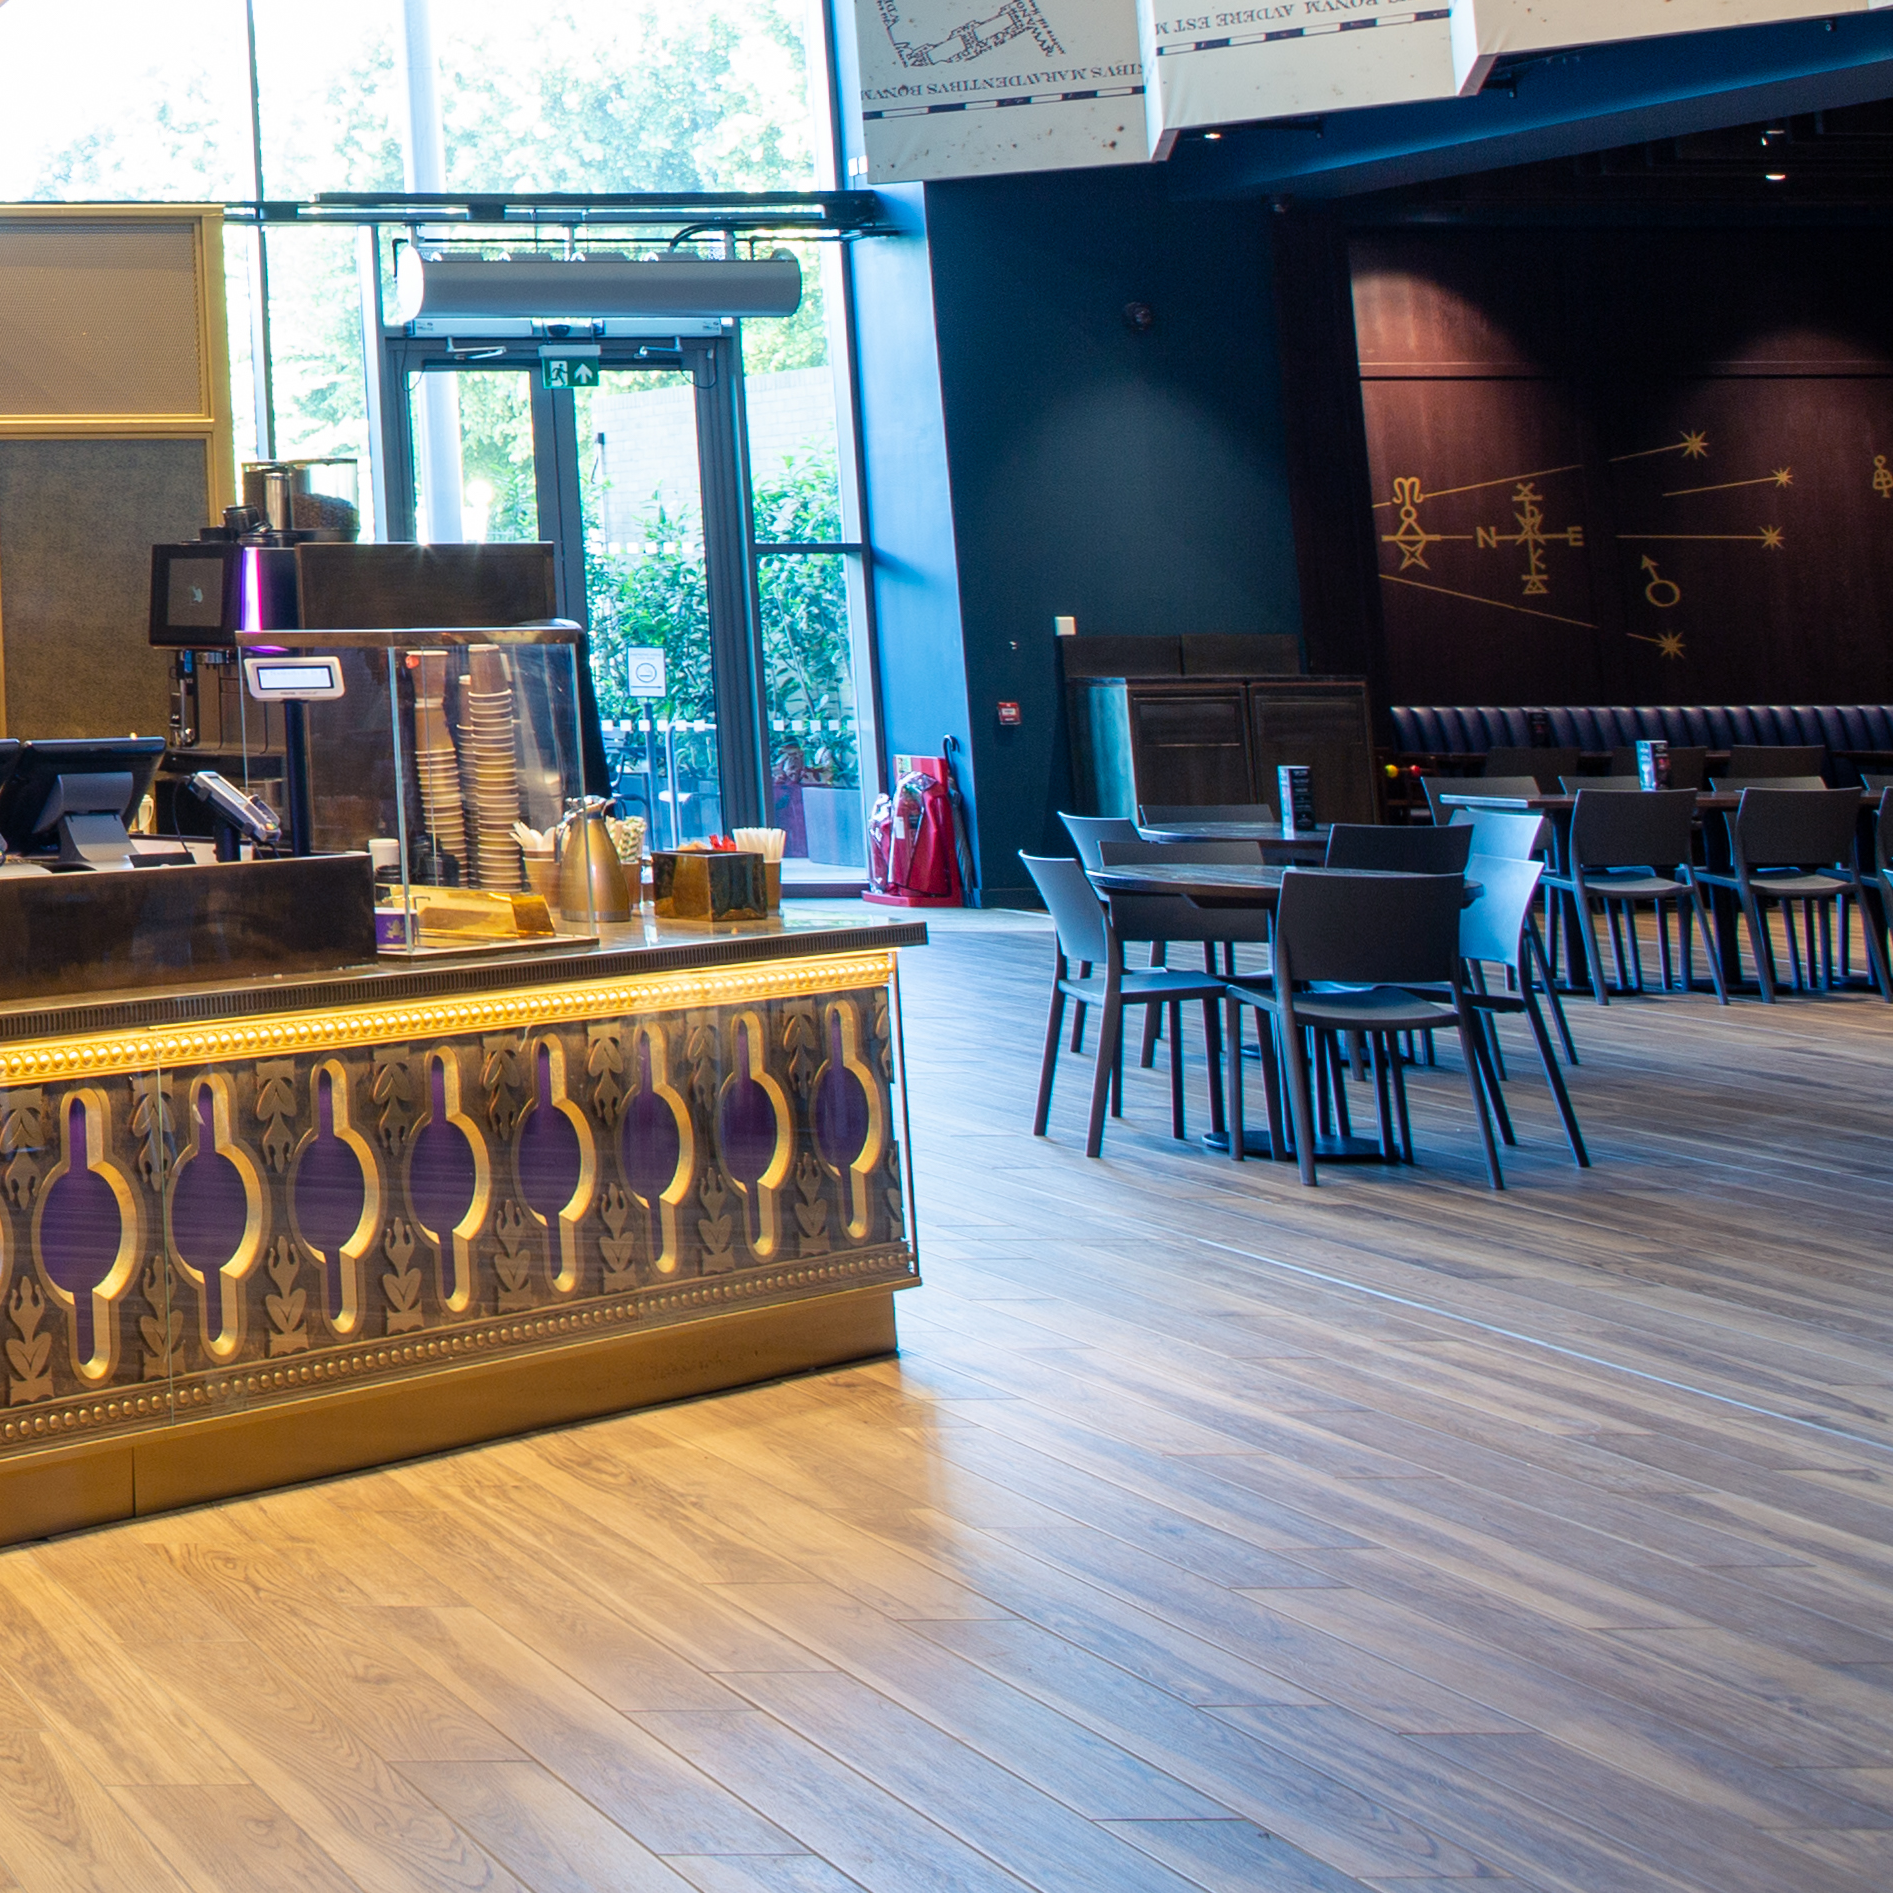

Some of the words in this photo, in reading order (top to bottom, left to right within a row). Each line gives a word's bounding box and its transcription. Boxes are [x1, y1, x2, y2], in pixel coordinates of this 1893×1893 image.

[1173, 16, 1210, 33] EST
[1215, 3, 1295, 27] AVDERE
[926, 68, 1087, 95] MARAVDENTIBVS
